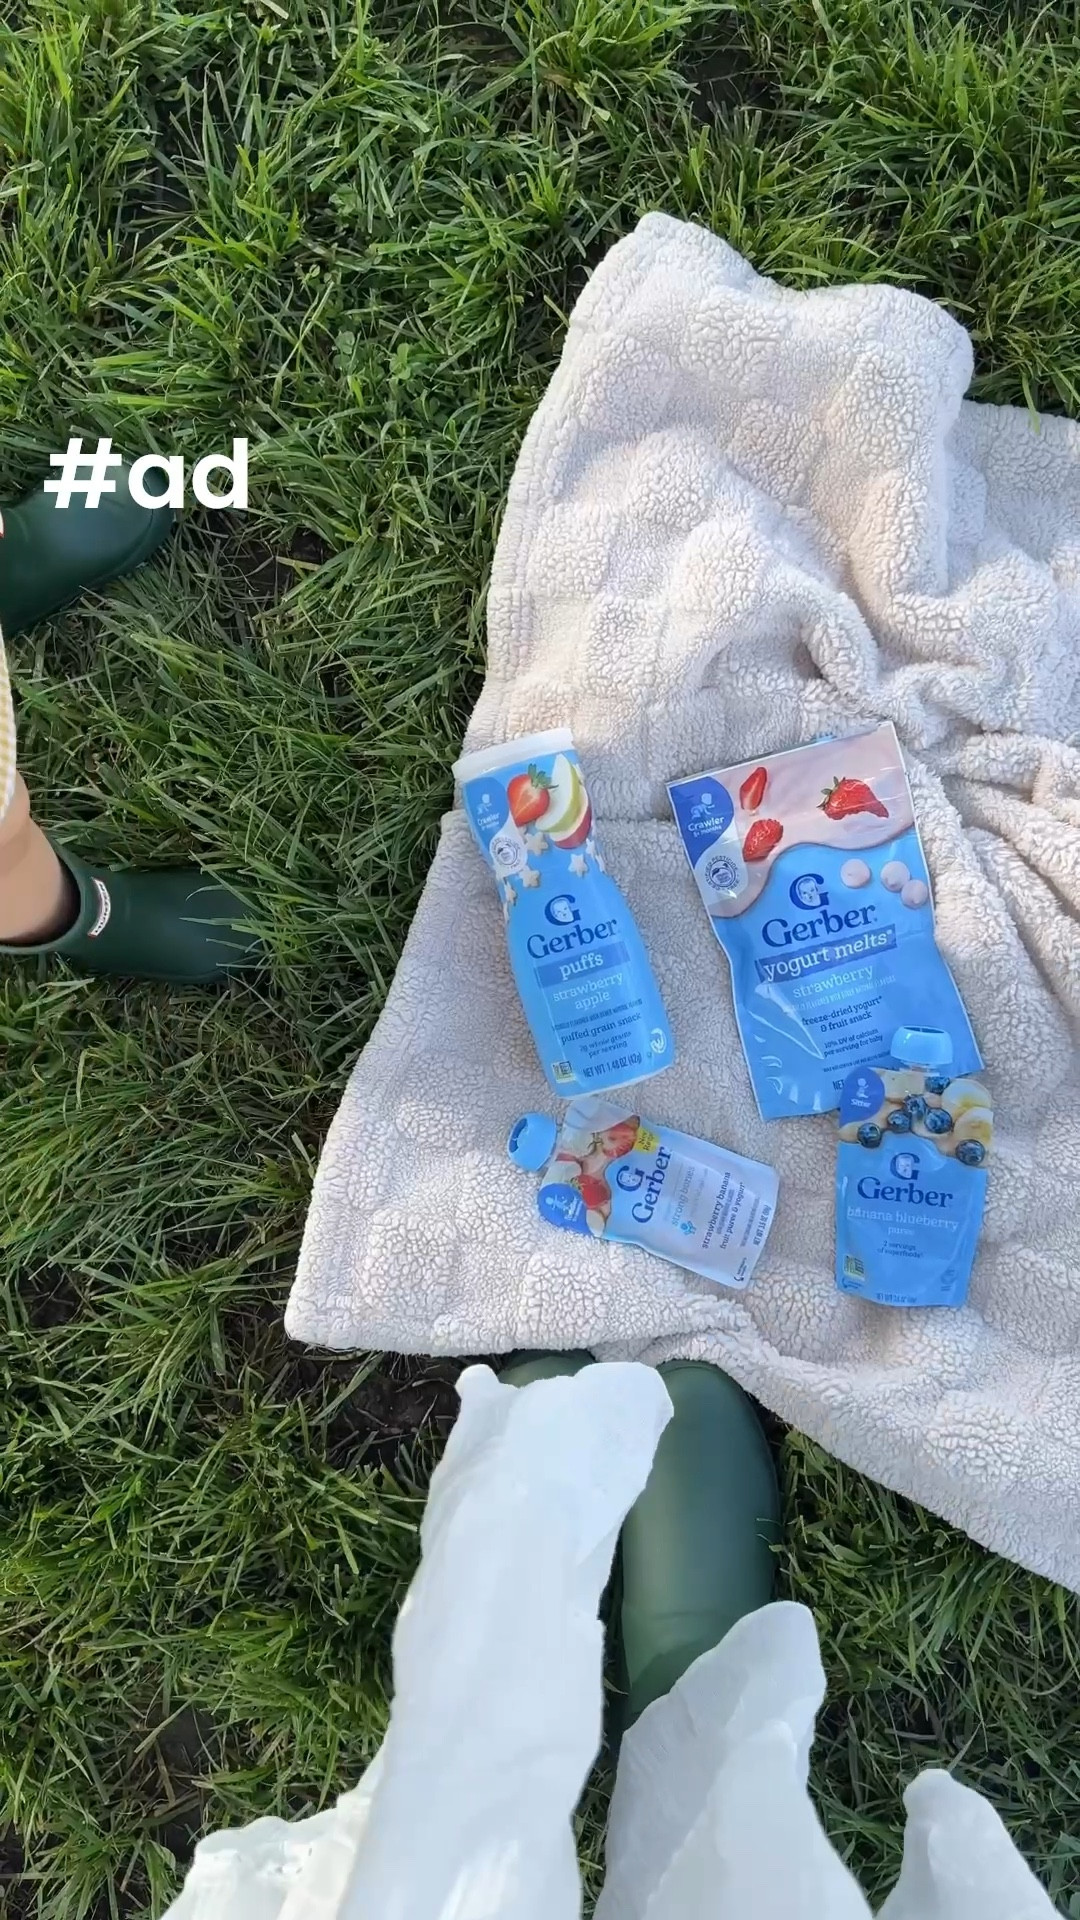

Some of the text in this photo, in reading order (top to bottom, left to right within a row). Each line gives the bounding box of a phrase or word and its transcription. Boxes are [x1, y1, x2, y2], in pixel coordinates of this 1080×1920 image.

[688, 816, 725, 832] Crawler
[527, 919, 617, 959] Gerber
[762, 904, 876, 948] Gerber
[559, 952, 604, 981] puffs
[763, 948, 830, 982] yogurt
[553, 973, 624, 1002] strawberry
[793, 965, 874, 999] strawberry
[575, 991, 610, 1011] apple
[802, 1005, 853, 1026] freeze-dried
[561, 1029, 589, 1045] puffed
[590, 1021, 616, 1037] grain
[618, 1012, 642, 1027] snack
[828, 1019, 849, 1031] fruit
[849, 1010, 873, 1024] snack
[823, 1034, 883, 1058] per serving for baby
[838, 1036, 848, 1045] DV
[855, 1028, 879, 1040] calcium
[588, 1050, 600, 1059] per
[582, 1066, 594, 1078] NET
[595, 1064, 606, 1076] WT
[632, 1146, 671, 1223] Gerber
[672, 1166, 695, 1226] strong bones
[857, 1176, 953, 1207] Gerber
[702, 1196, 724, 1249] strawberry
[719, 1171, 731, 1200] banana
[847, 1206, 959, 1233] banana blueberry
[720, 1232, 731, 1249] fruit
